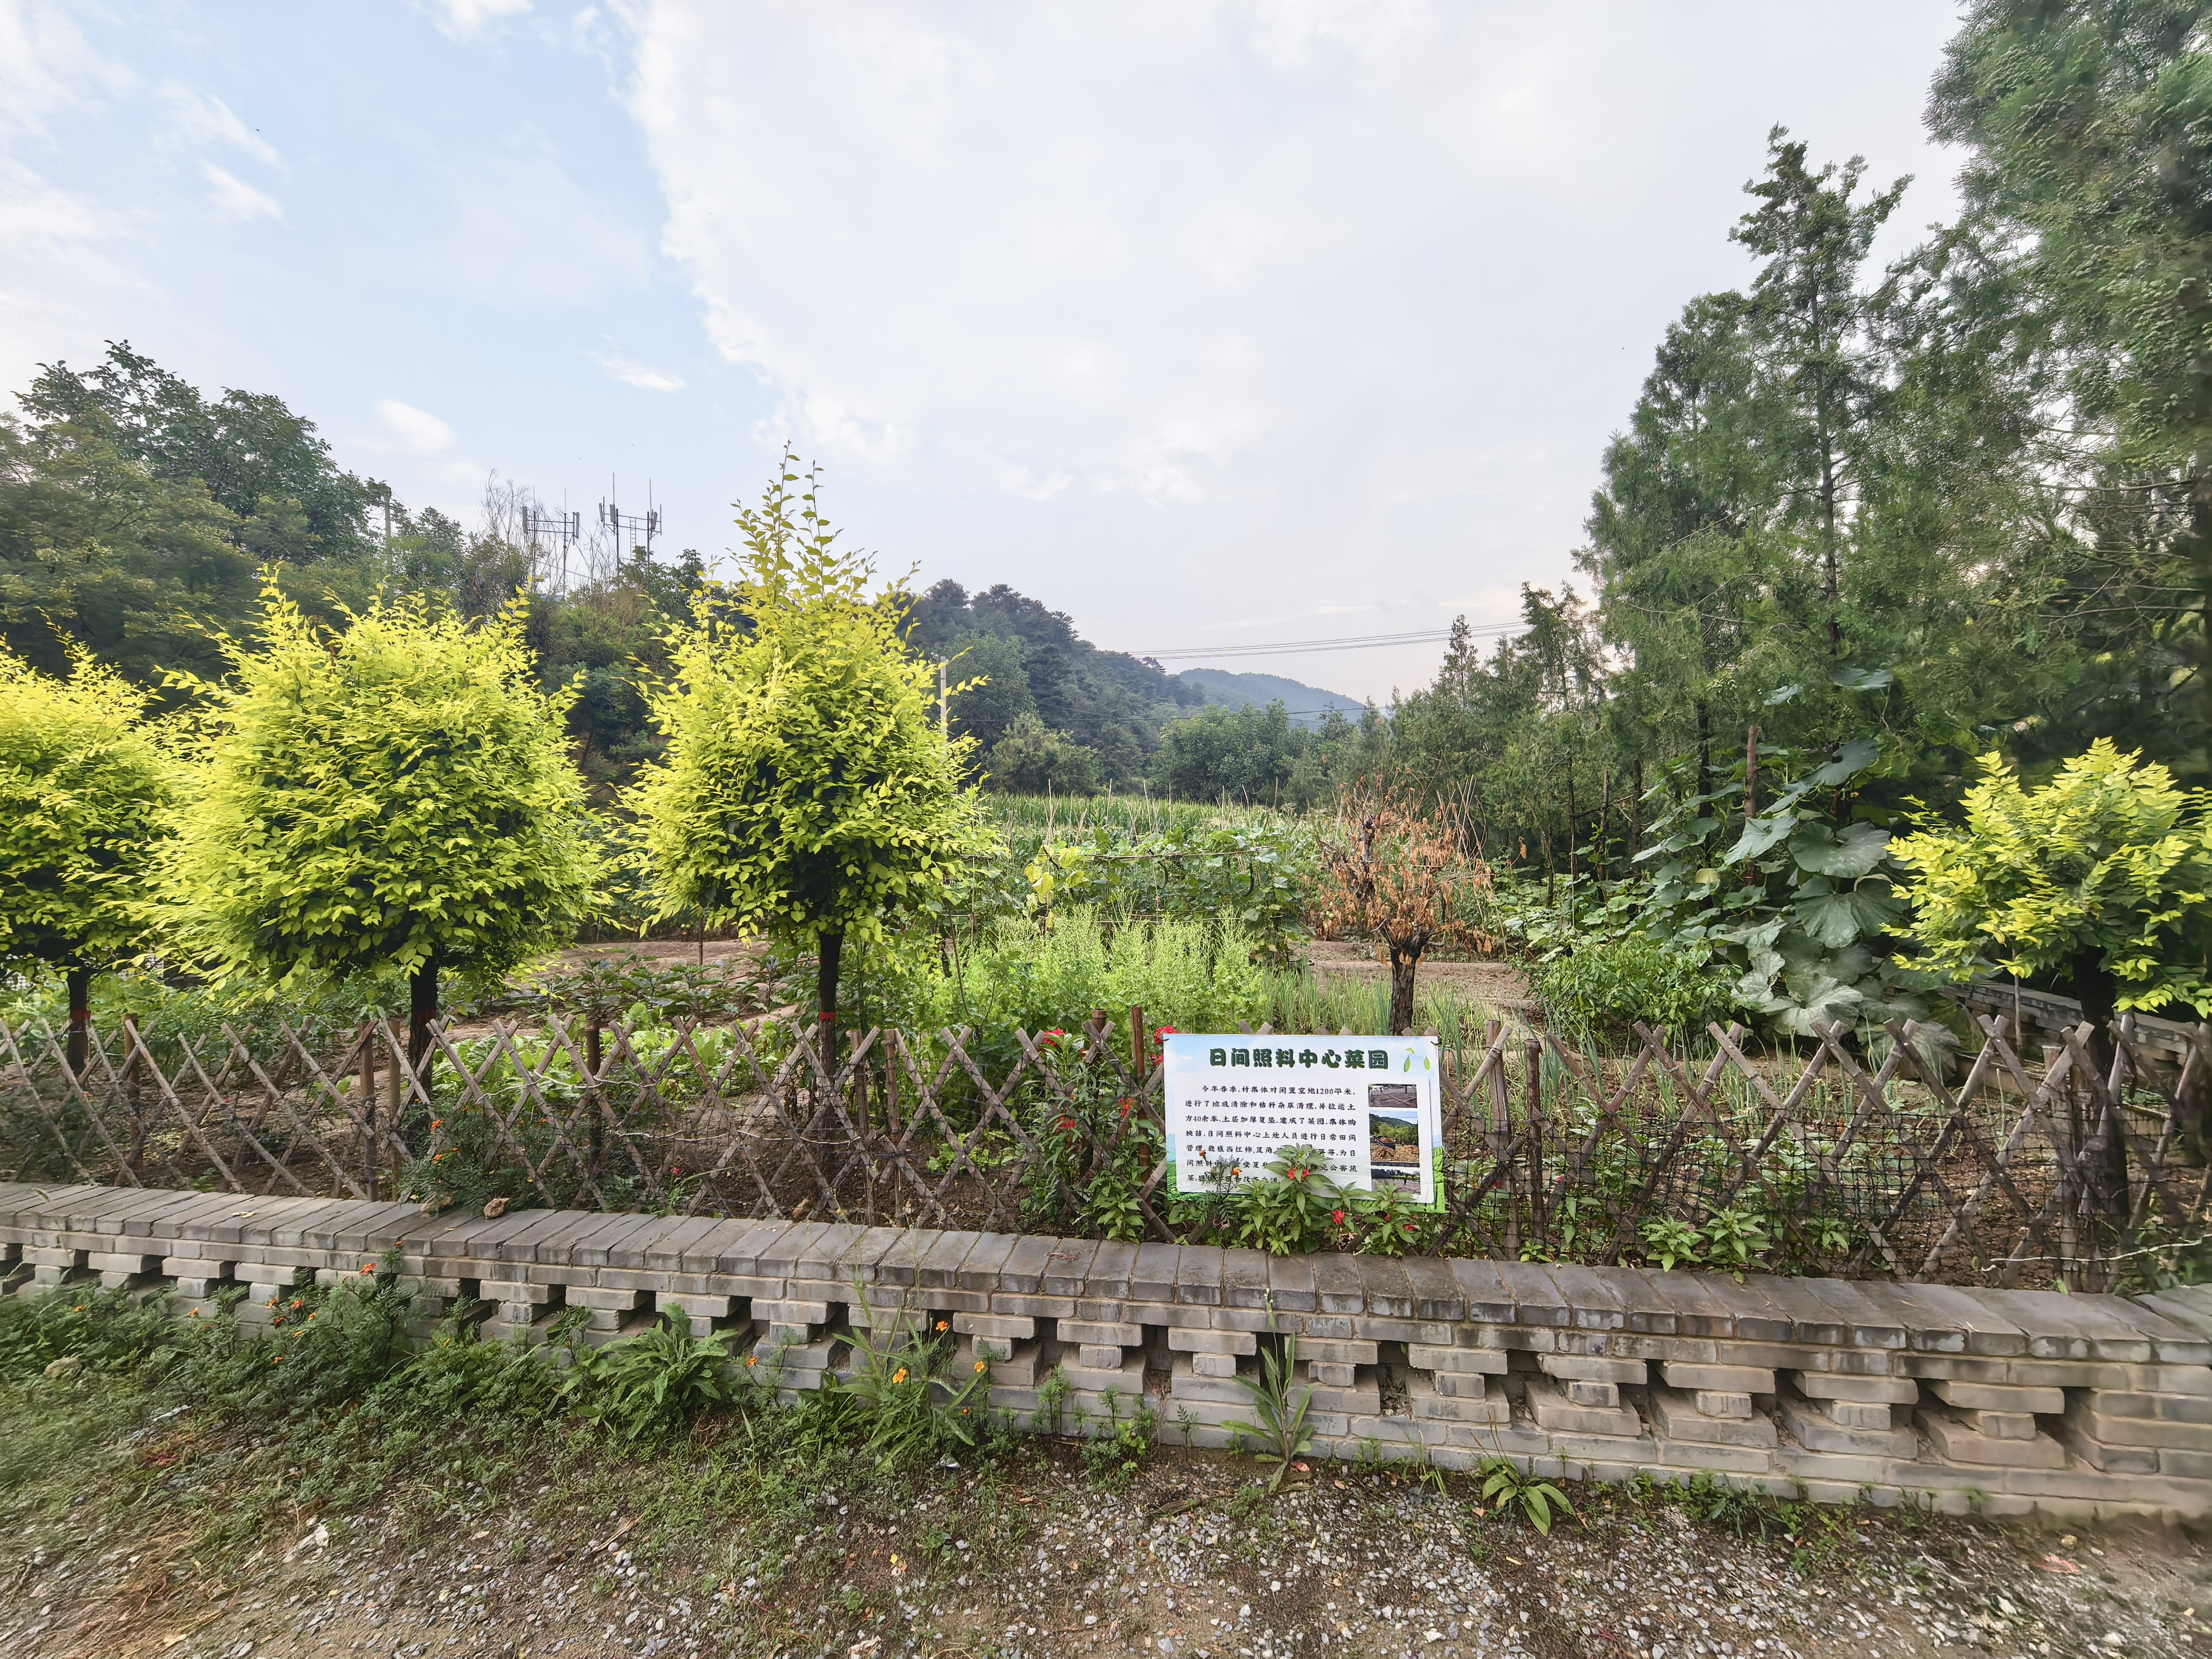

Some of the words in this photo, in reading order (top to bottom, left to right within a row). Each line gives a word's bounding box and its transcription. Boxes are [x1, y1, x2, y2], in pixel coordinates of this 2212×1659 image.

[1209, 1048, 1390, 1070] 日间照料中心菜园
